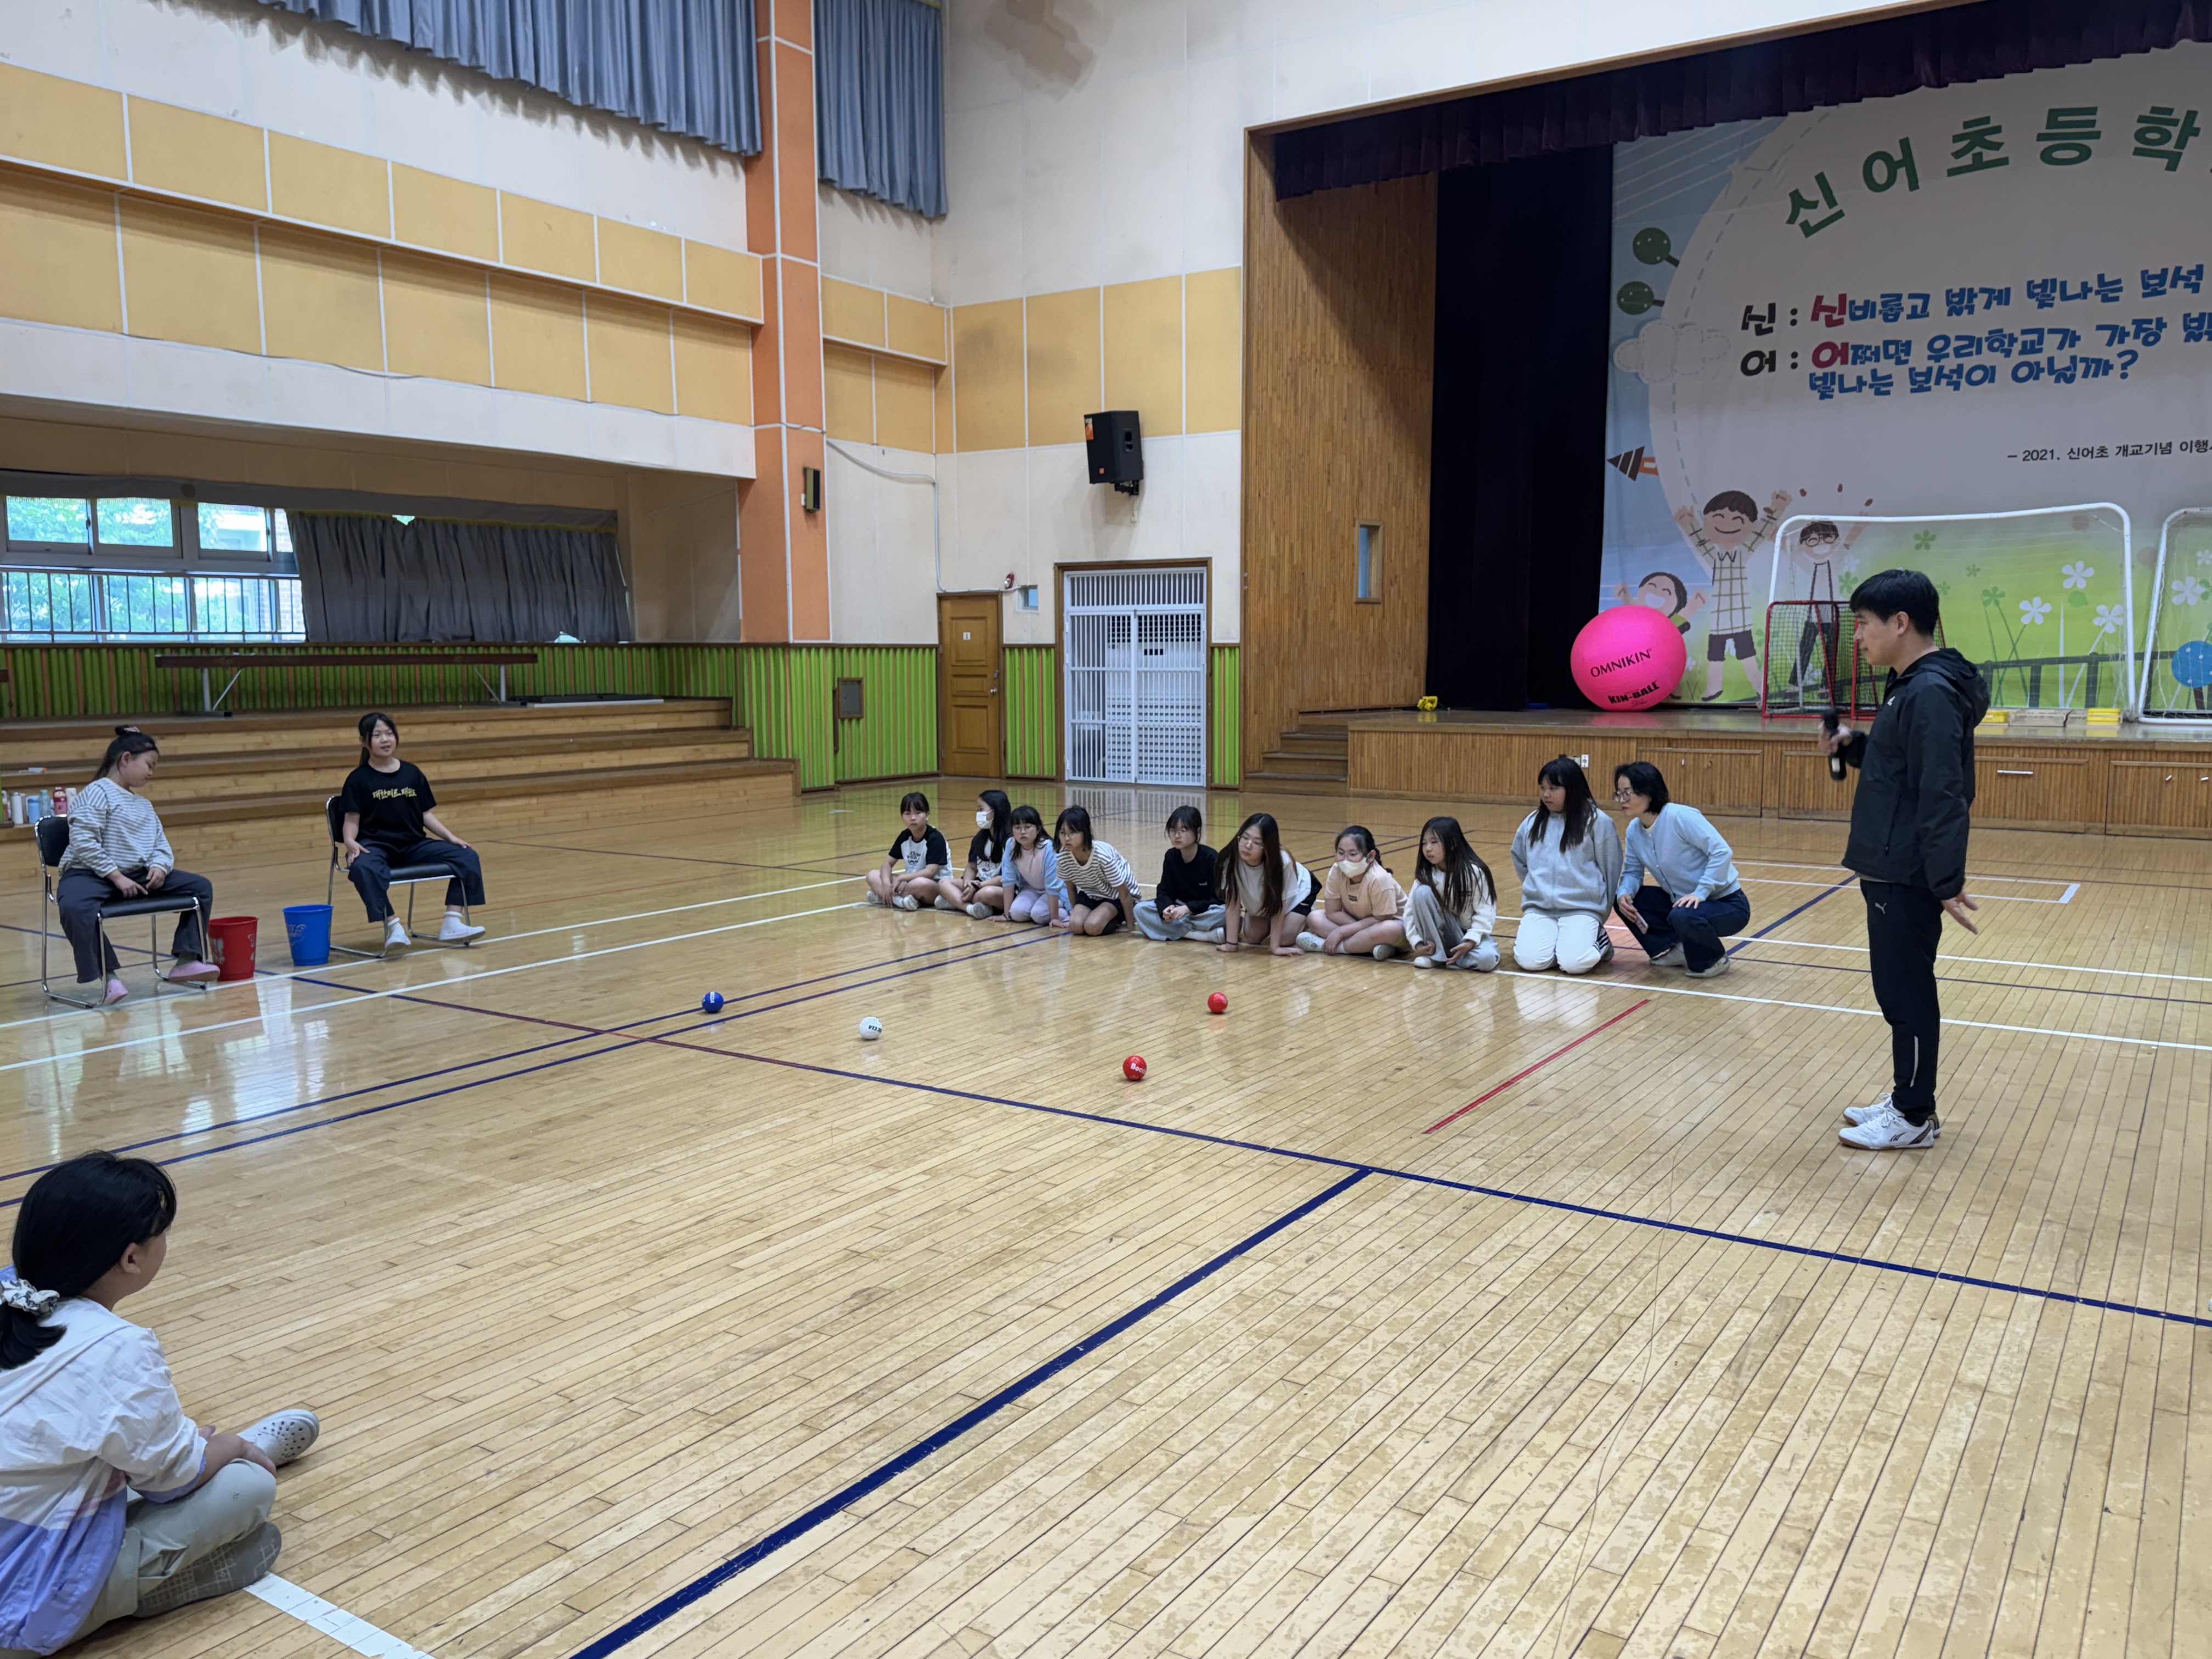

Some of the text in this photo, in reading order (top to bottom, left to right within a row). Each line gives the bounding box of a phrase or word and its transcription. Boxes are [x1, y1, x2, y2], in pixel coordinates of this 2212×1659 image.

[1786, 106, 2212, 238] 신어초등학
[1741, 302, 1776, 336] 신
[1811, 293, 1931, 328] 신비롭고
[1945, 287, 2011, 315] 밝게
[2027, 273, 2123, 309] 빛나는
[2141, 264, 2204, 298] 보석
[1741, 350, 1776, 376] 어
[1812, 340, 1912, 369] 어쩌면
[1927, 328, 2081, 363] 우리학교가
[2095, 317, 2168, 347] 가장
[1809, 349, 2138, 400] 빛나는 보석이 아닐까?
[2022, 448, 2061, 461] 2021.
[2067, 446, 2109, 460] 신어초
[2115, 441, 2172, 457] 개교기념
[2180, 439, 2212, 453] 이행
[1590, 649, 1651, 678] OMNIKIN
[1608, 681, 1660, 704] KIN-BALL
